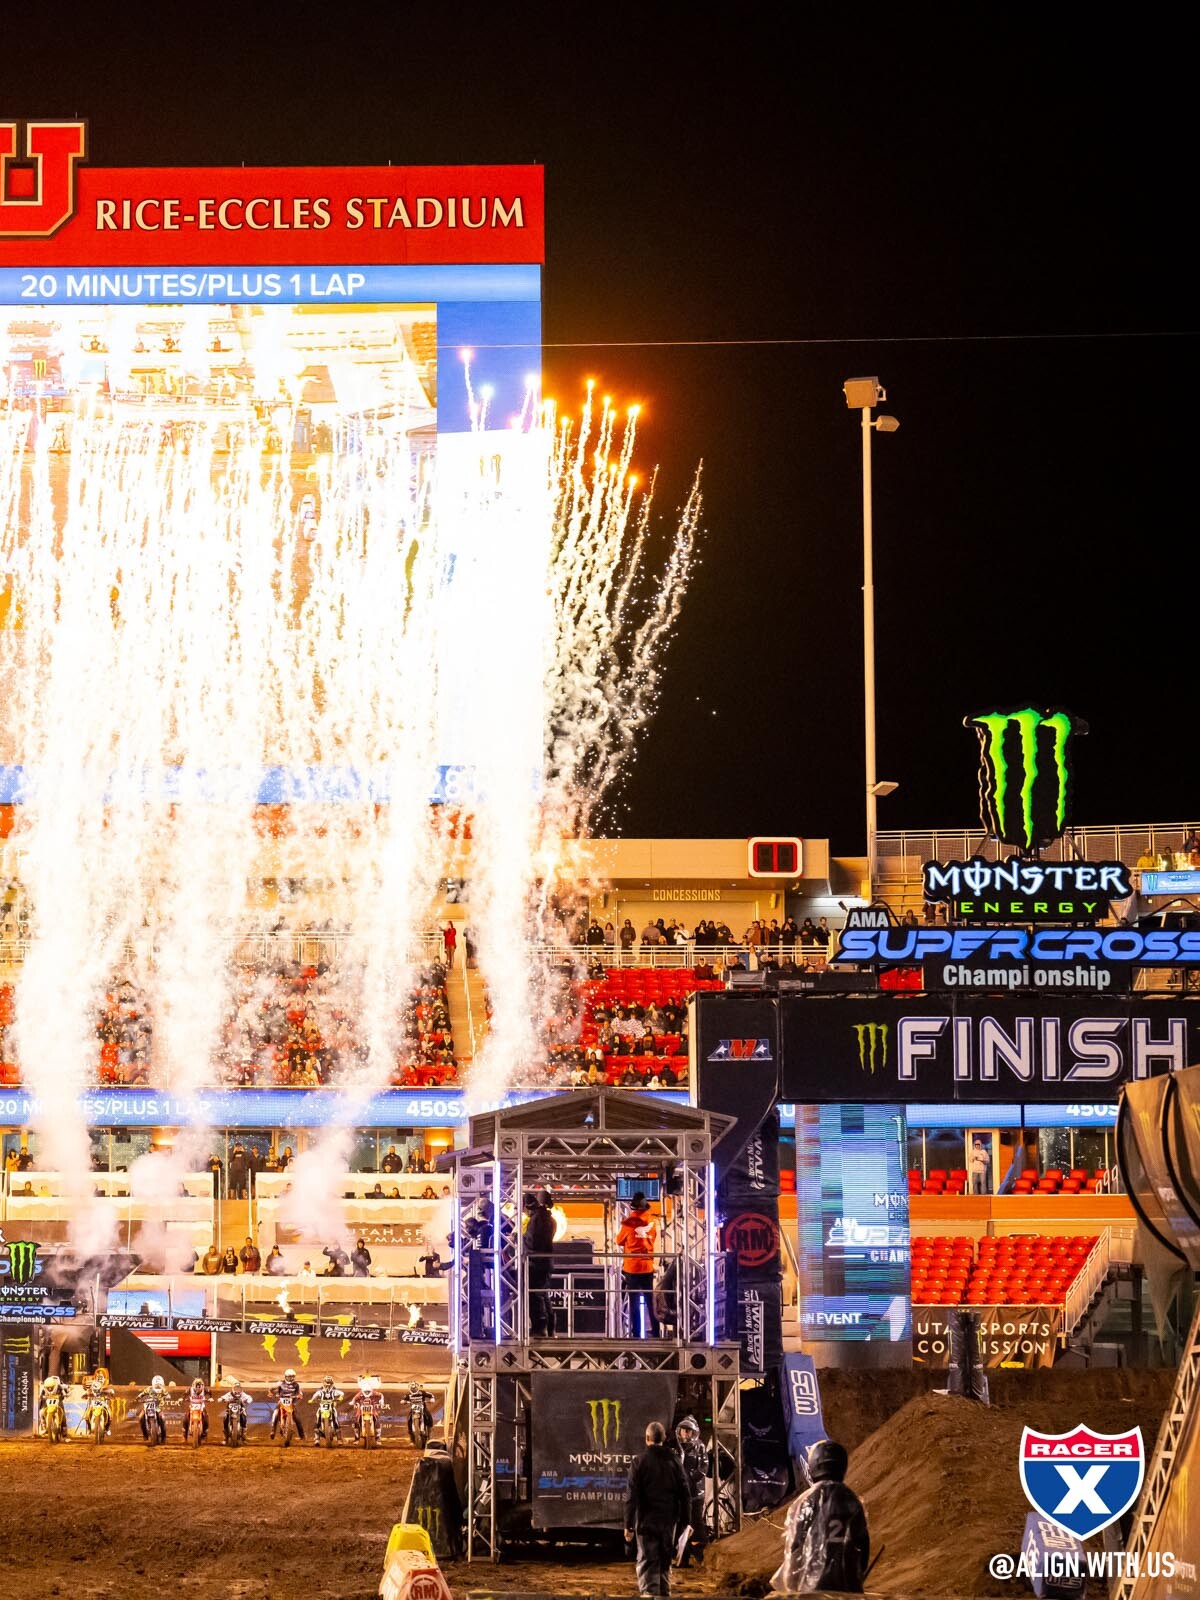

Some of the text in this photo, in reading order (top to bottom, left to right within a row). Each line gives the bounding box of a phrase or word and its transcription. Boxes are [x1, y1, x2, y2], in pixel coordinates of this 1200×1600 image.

[95, 197, 525, 231] RICE-ECCLES STADIUM
[21, 274, 57, 298] 20
[66, 273, 281, 298] MINUTES/PLUS
[290, 274, 301, 297] 1
[309, 273, 366, 297] LAP
[928, 861, 1129, 897] MONSTER
[653, 889, 720, 901] CONCESSIONS
[961, 902, 1097, 913] ENERGY
[850, 913, 889, 928] AMA
[707, 1039, 773, 1060] AMA
[897, 1016, 1188, 1081] FINISH
[163, 1102, 171, 1115] 1
[816, 1313, 862, 1325] EVENT
[979, 1323, 1050, 1337] SPORTS
[917, 1340, 1047, 1355] COISSION
[827, 1519, 845, 1542] 2
